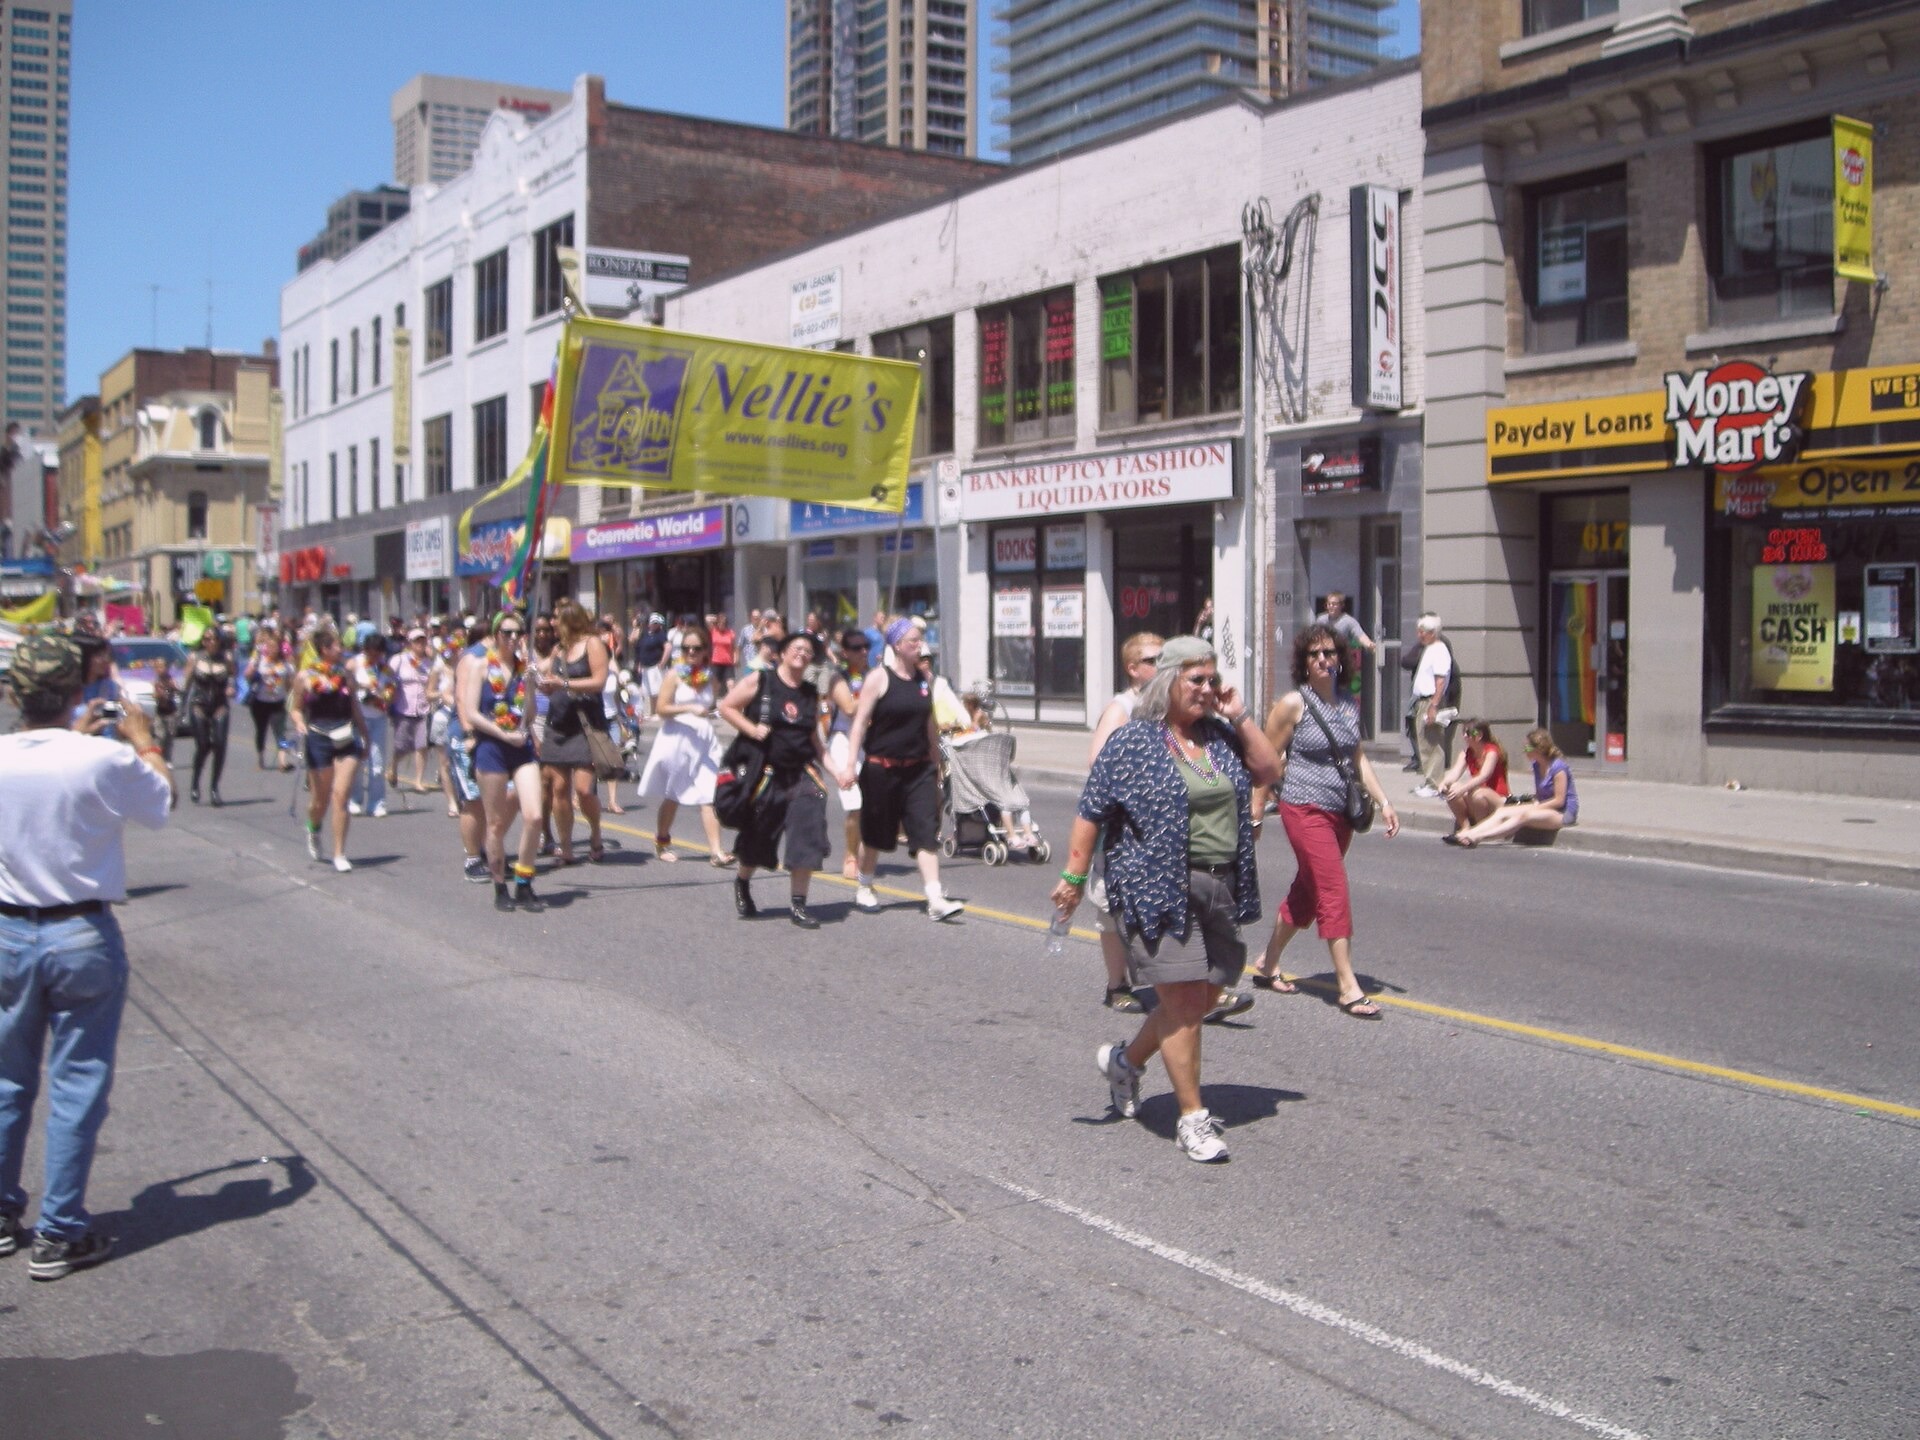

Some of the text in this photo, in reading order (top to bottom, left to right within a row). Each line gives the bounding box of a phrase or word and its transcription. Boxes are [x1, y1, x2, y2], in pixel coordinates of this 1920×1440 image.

[792, 272, 837, 294] NOW LEASING
[693, 360, 892, 433] Nellie's
[1664, 369, 1806, 423] Money
[1873, 376, 1920, 396] WES
[1494, 411, 1654, 447] Payday Loans
[1674, 419, 1784, 467] Mart
[725, 431, 849, 460] www.nellies.org
[971, 446, 1227, 492] BANKRUPTCY FASHION
[1800, 466, 1891, 501] Open
[1018, 477, 1171, 511] LIQUIDATORS
[1724, 497, 1769, 516] Mart
[586, 512, 704, 548] Cosmetic World
[1583, 521, 1628, 552] 617
[1768, 528, 1821, 545] OPEN
[996, 537, 1036, 561] BOOKS
[1121, 586, 1149, 618] 90
[1767, 603, 1819, 616] INSTANT
[1760, 617, 1827, 643] CASH
